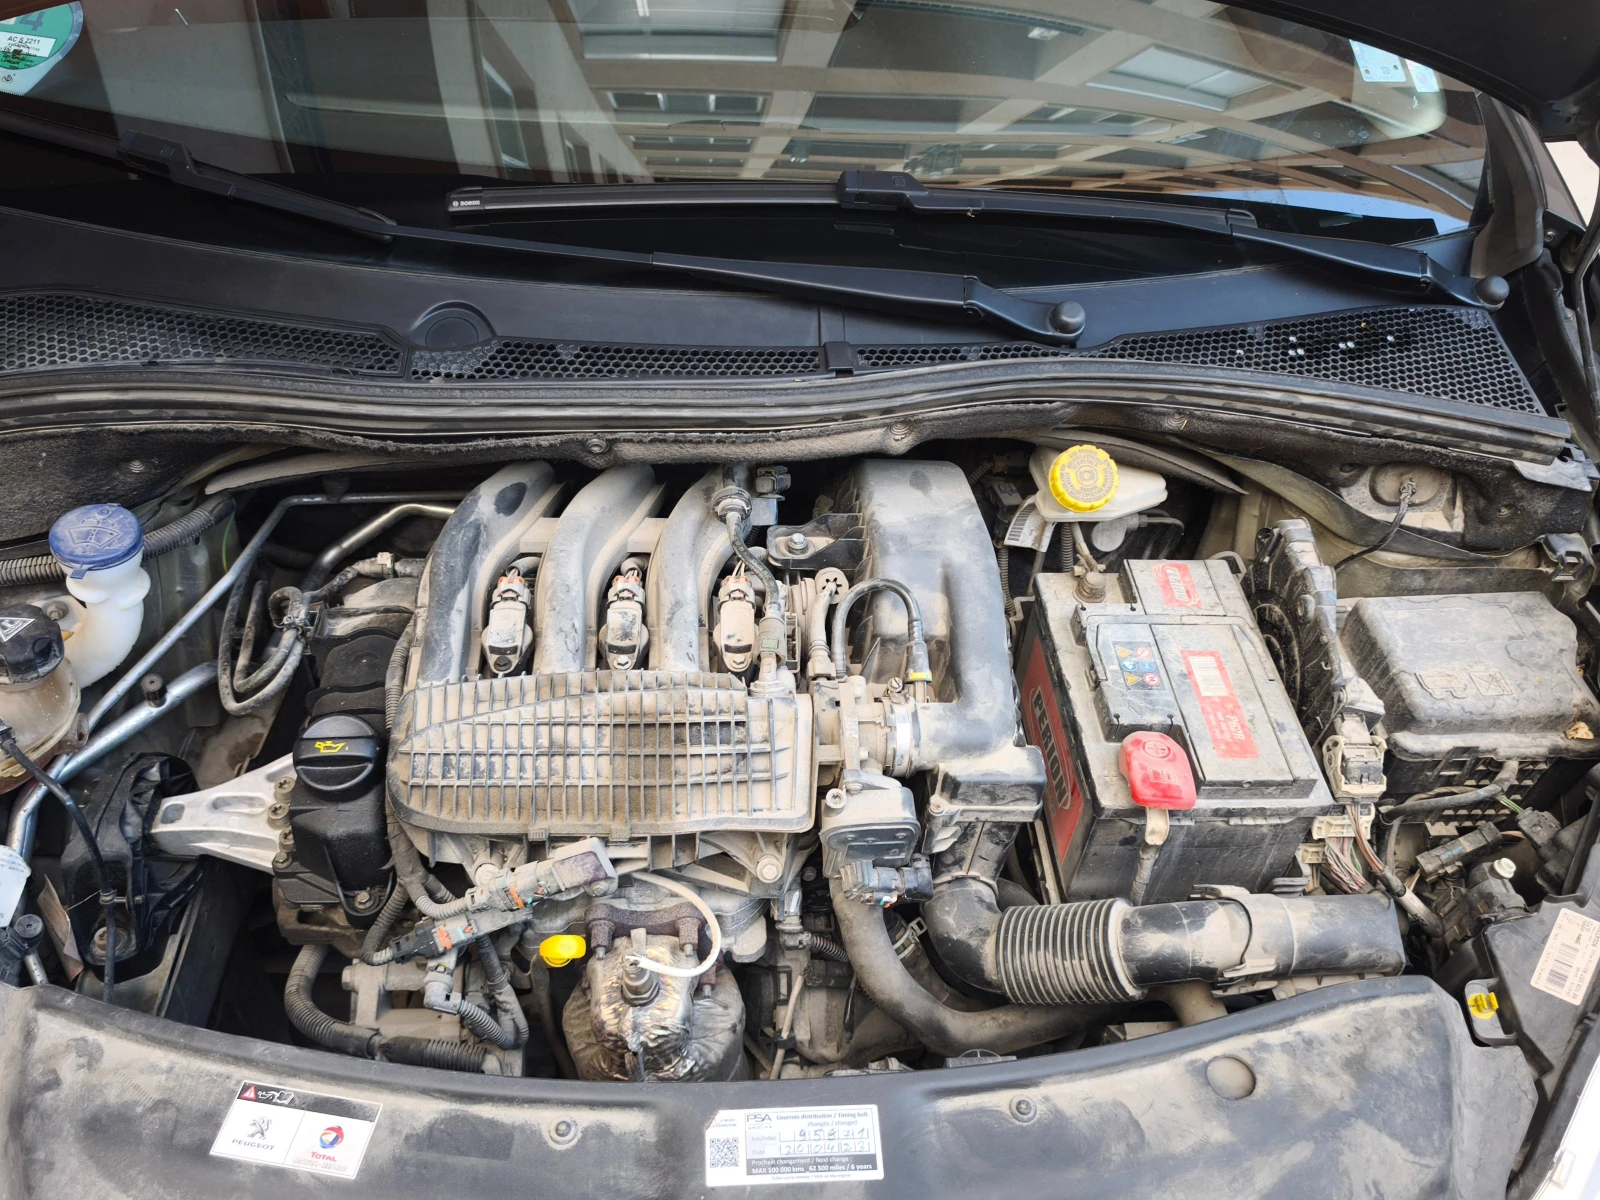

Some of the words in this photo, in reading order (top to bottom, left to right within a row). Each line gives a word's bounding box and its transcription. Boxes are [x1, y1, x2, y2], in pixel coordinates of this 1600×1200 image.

[1034, 690, 1069, 804] PERION
[746, 1113, 772, 1123] PSA
[231, 1138, 275, 1151] PEUGEOT
[310, 1151, 337, 1162] TOTAL
[751, 1158, 775, 1166] Prochain
[777, 1157, 810, 1165] changement
[829, 1163, 845, 1171] miles
[855, 1163, 872, 1171] years
